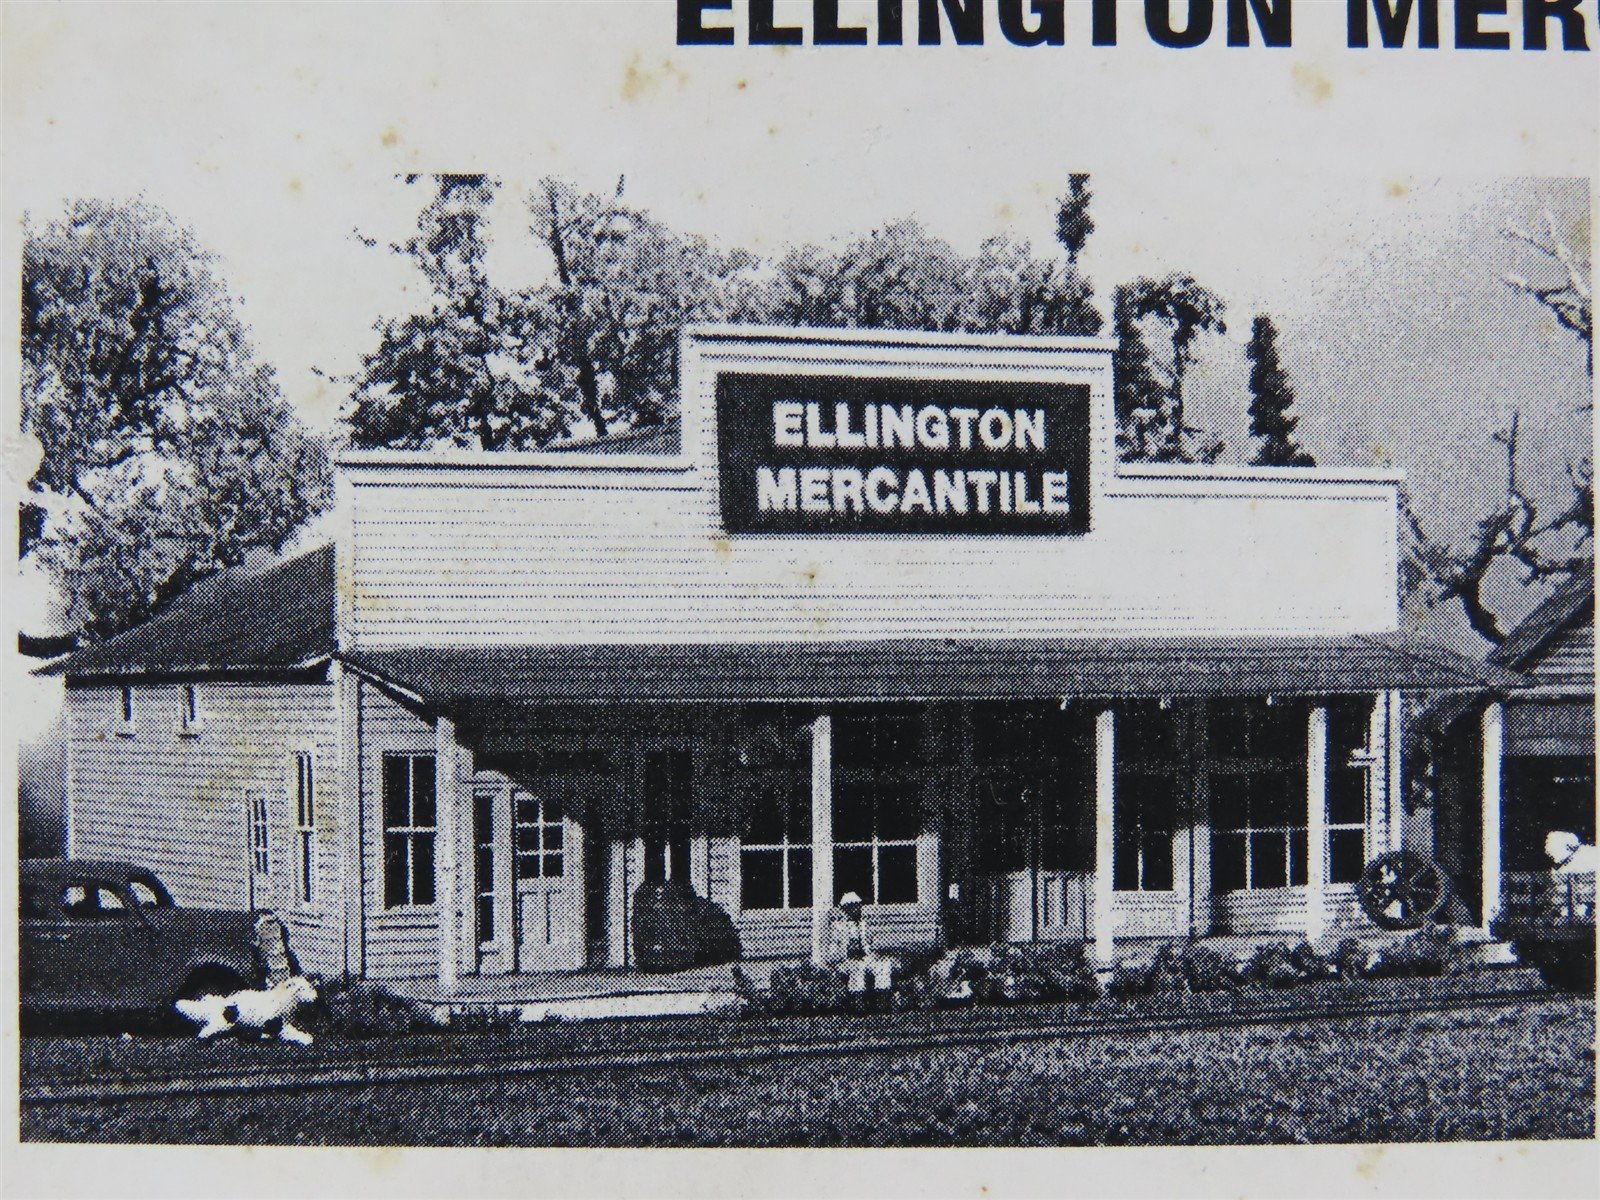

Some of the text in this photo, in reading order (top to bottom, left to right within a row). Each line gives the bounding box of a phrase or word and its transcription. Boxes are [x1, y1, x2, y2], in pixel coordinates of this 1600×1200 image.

[677, 0, 1600, 52] ELLINGTON MER
[773, 401, 1047, 450] ELLINGTON
[757, 466, 1070, 514] MERCANTILE
